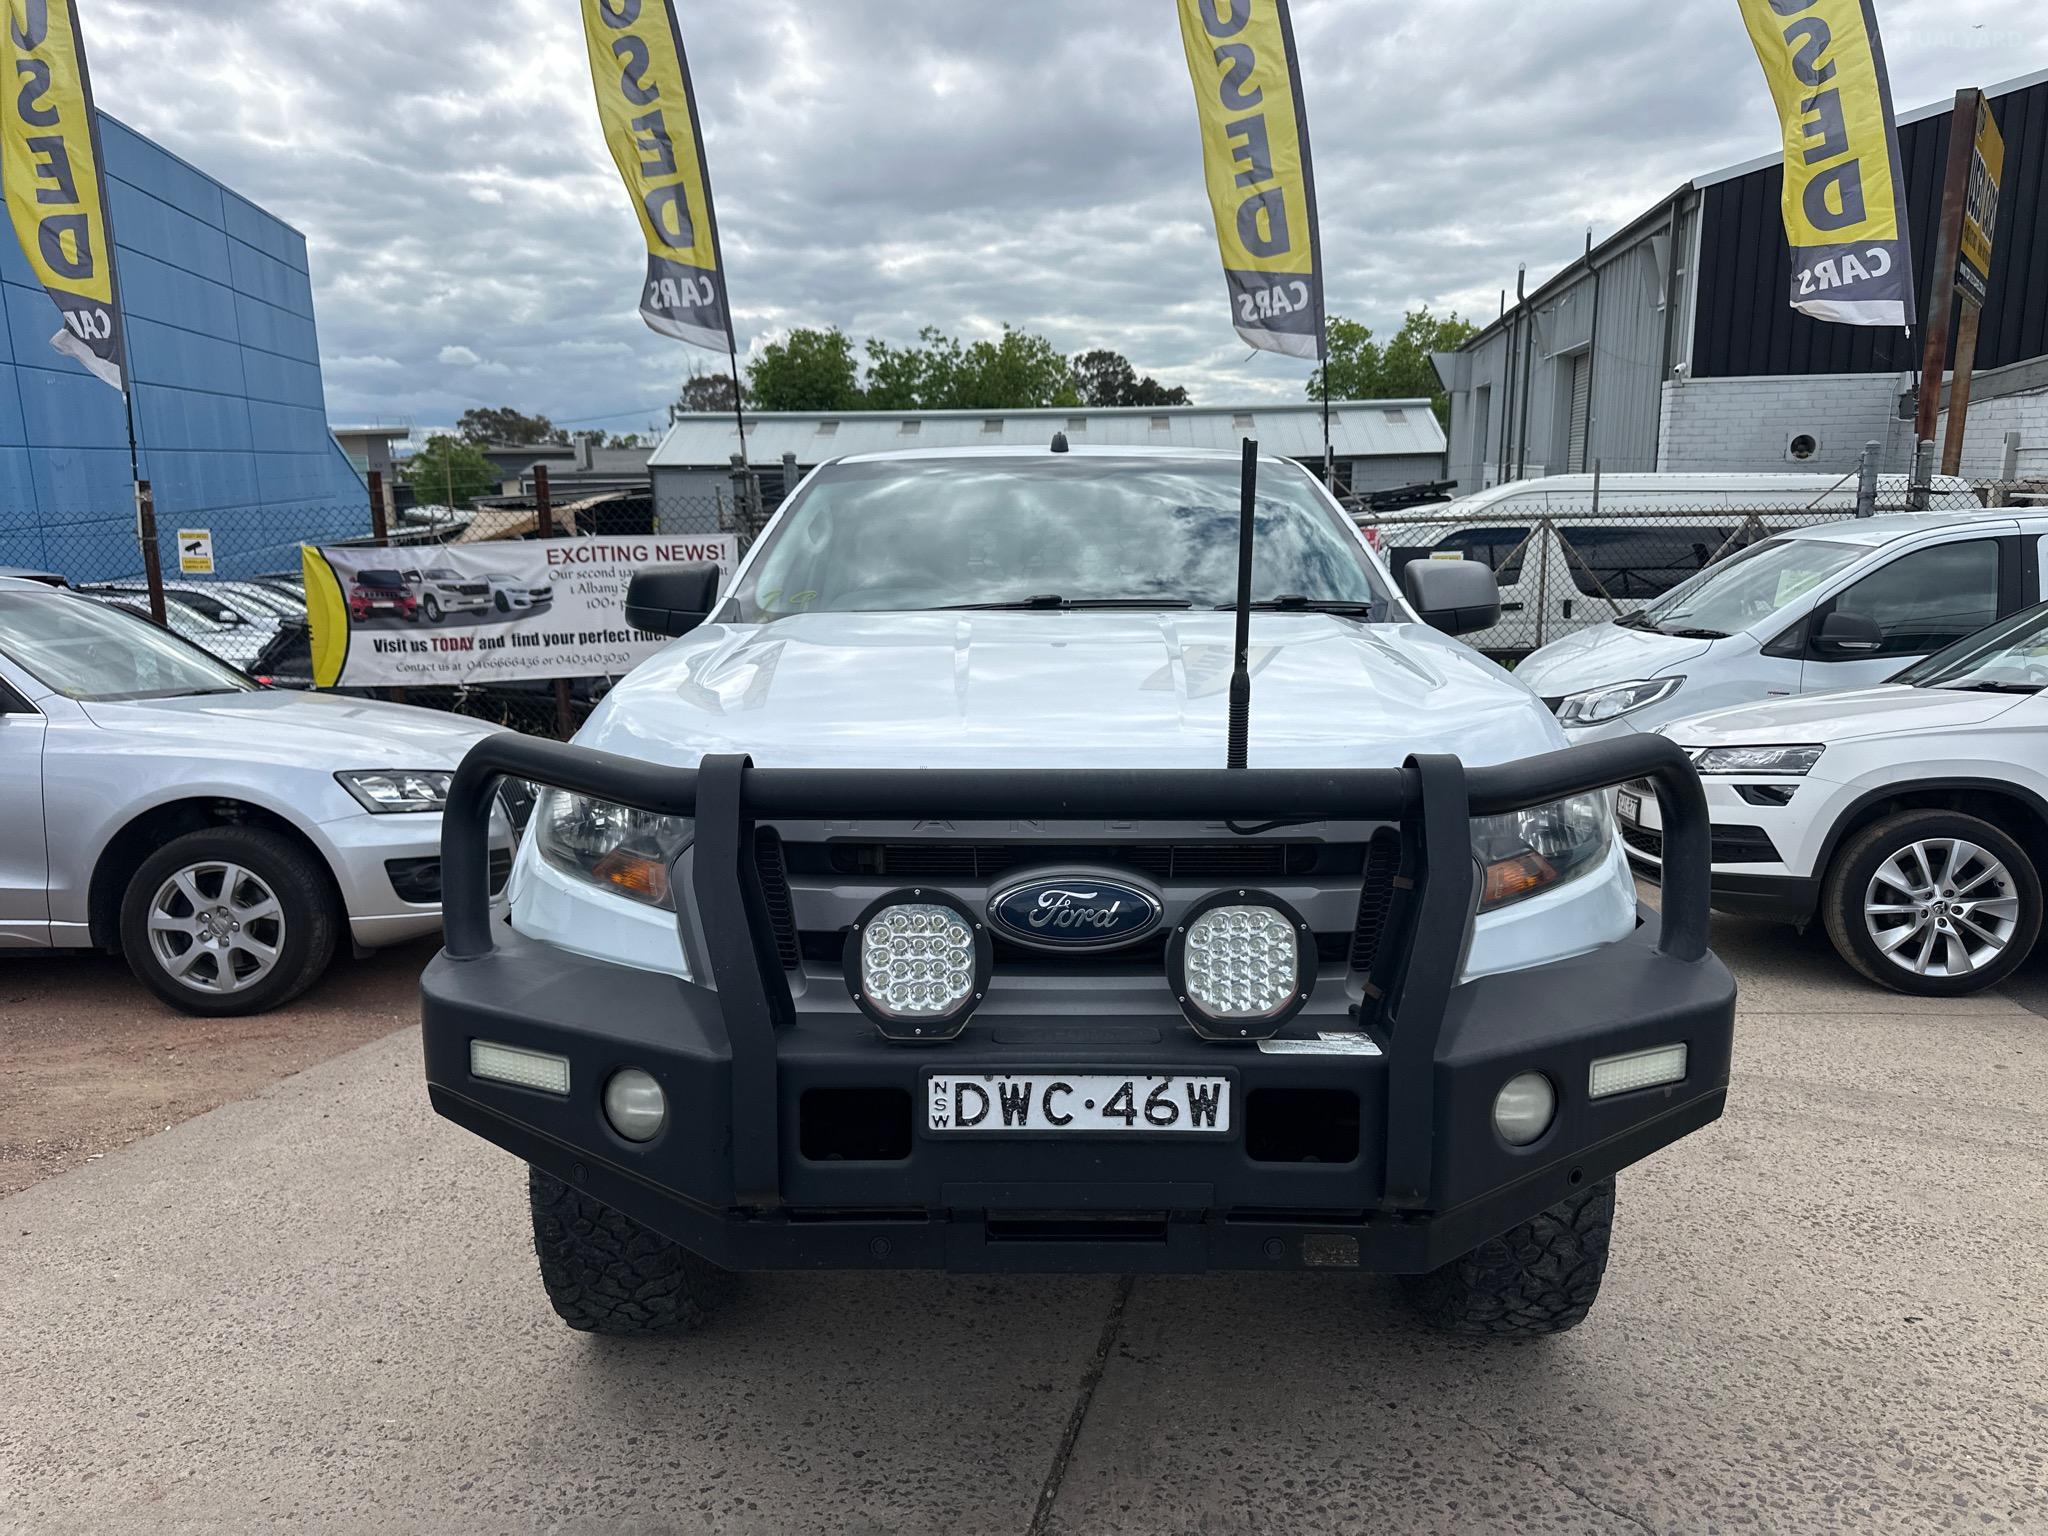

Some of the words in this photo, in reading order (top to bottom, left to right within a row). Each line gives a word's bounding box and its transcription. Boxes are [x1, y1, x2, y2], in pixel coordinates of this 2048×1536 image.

[546, 545, 648, 565] EXCITING
[656, 544, 726, 561] NEWS!
[549, 568, 572, 581] Our
[576, 566, 616, 579] second
[577, 582, 618, 597] Albany
[373, 638, 407, 653] Visit
[410, 640, 428, 652] us
[431, 636, 474, 652] TODAY
[478, 635, 506, 650] and
[511, 632, 540, 647] find
[542, 632, 576, 647] your
[578, 629, 632, 646] perfect
[396, 662, 436, 673] Contact
[439, 664, 450, 672] us
[452, 662, 462, 672] at
[542, 656, 553, 666] or
[1028, 890, 1121, 928] Ford
